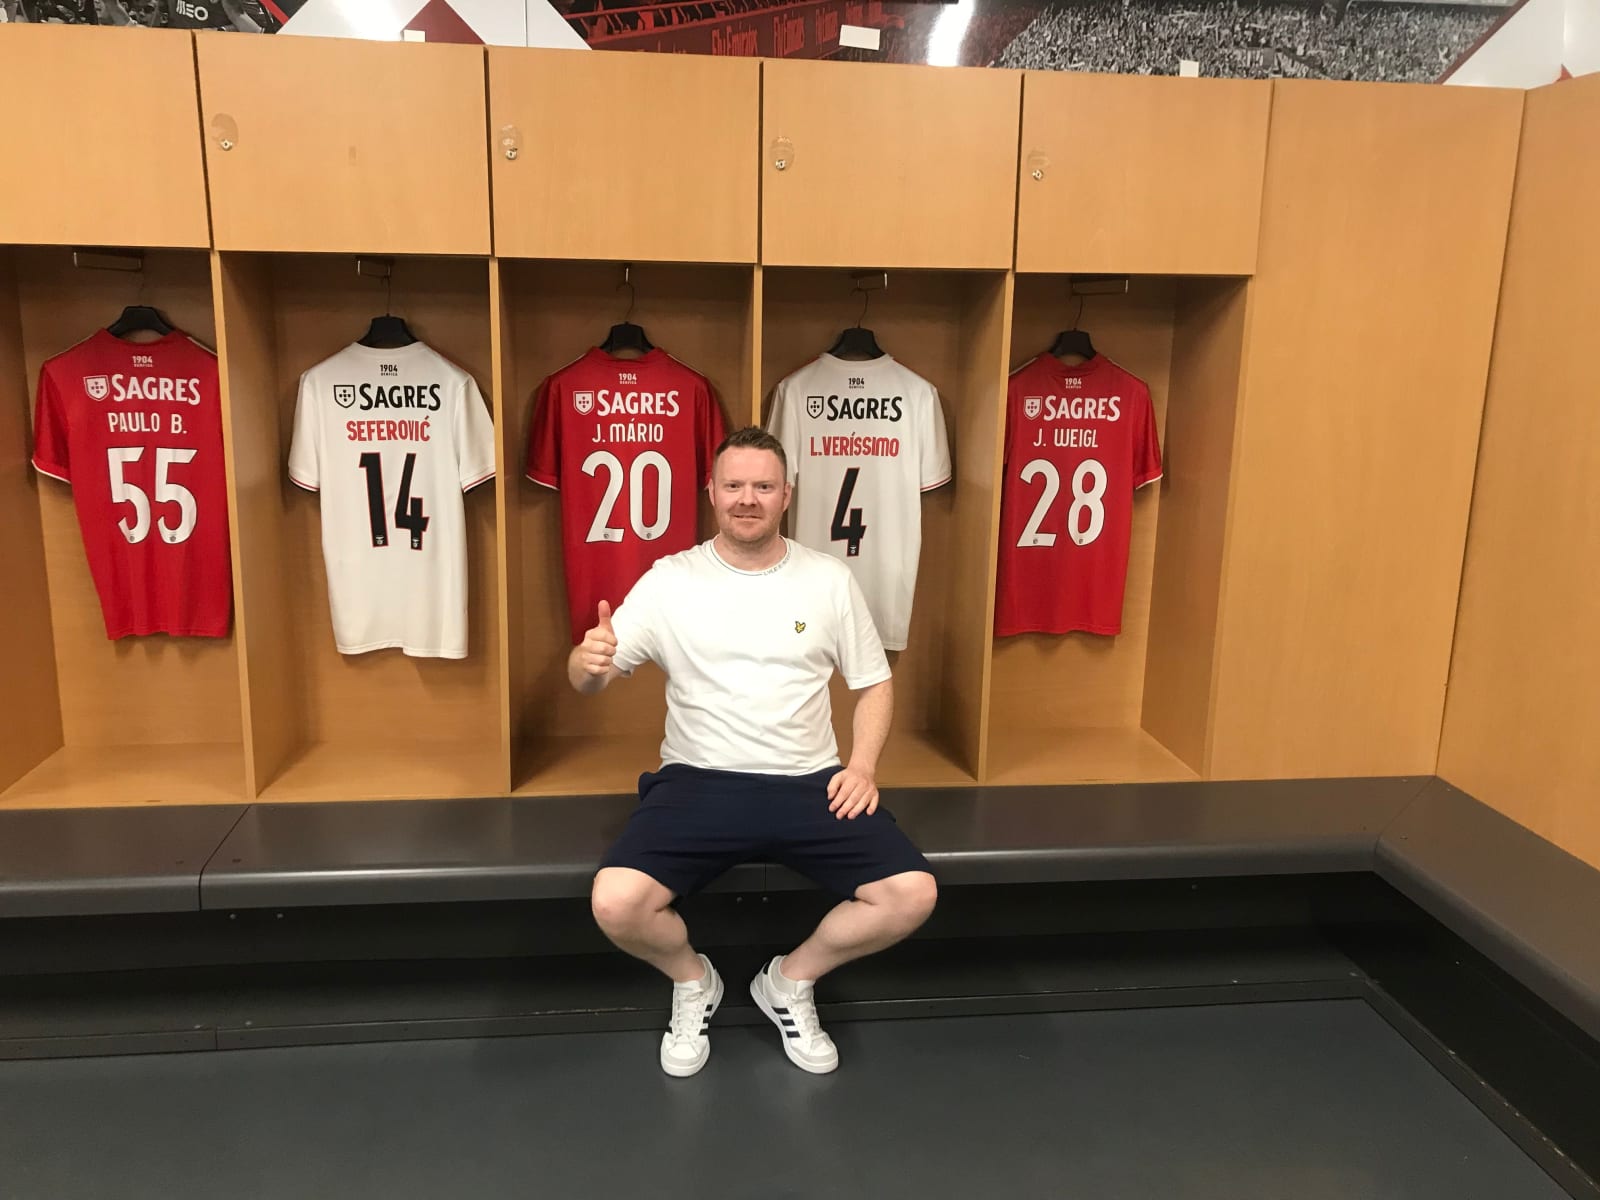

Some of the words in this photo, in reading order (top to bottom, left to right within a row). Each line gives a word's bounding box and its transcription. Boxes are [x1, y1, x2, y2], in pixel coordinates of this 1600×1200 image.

[176, 0, 209, 21] MEO
[132, 355, 153, 364] 1904
[380, 364, 398, 373] 1904
[111, 373, 201, 406] SAGRES
[618, 372, 637, 381] 1904
[848, 377, 865, 386] 1904
[1065, 377, 1082, 385] 1904
[358, 383, 441, 411] SAGRES
[597, 389, 680, 417] SAGRES
[826, 394, 902, 422] SAGRES
[1043, 395, 1121, 422] SAGRES
[107, 412, 160, 433] PAULO
[170, 413, 188, 434] B.
[346, 415, 431, 442] SEFEROVIĆ
[592, 423, 606, 443] J.
[609, 417, 664, 443] MÁRIO
[1033, 428, 1047, 447] J.
[1053, 428, 1099, 448] WEIGL
[107, 446, 198, 544] 55
[358, 451, 430, 551] 14
[581, 450, 673, 543] 20
[1016, 458, 1109, 548] 28
[830, 467, 868, 558] 4
